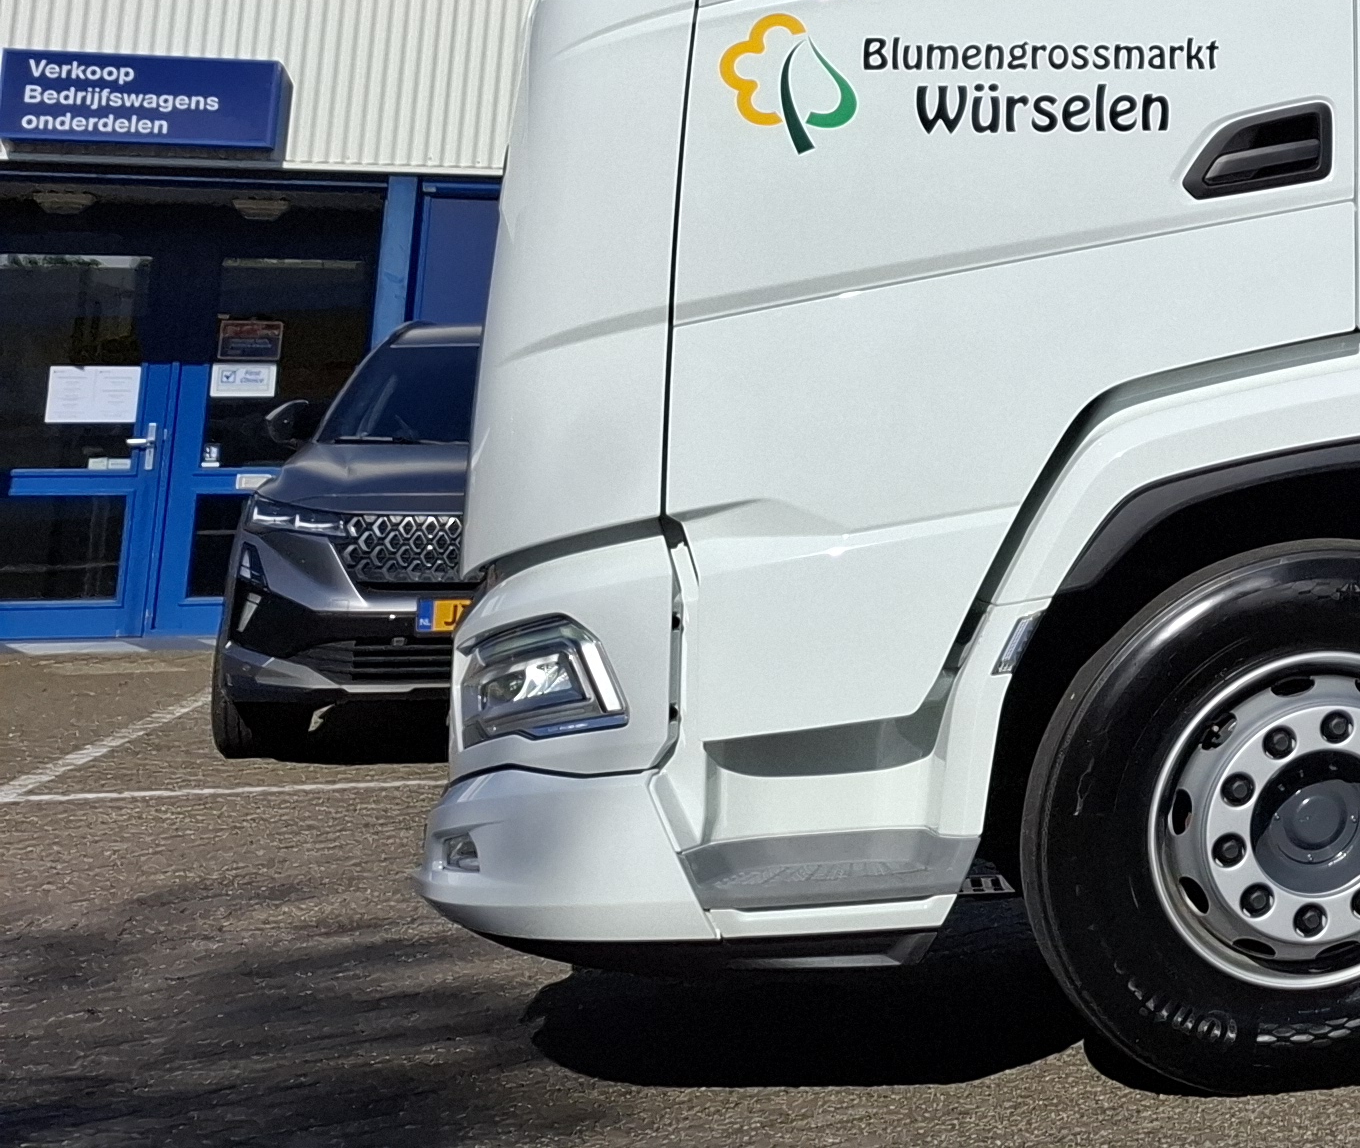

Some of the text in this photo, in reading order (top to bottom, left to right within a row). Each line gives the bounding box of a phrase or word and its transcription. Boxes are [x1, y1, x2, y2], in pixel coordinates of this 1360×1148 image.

[862, 36, 1220, 71] Blumengrossmarkt
[28, 58, 136, 85] Verkoop
[23, 84, 220, 113] Bedrijfswagens
[915, 83, 1171, 135] Würselen
[21, 112, 169, 135] onderdelen
